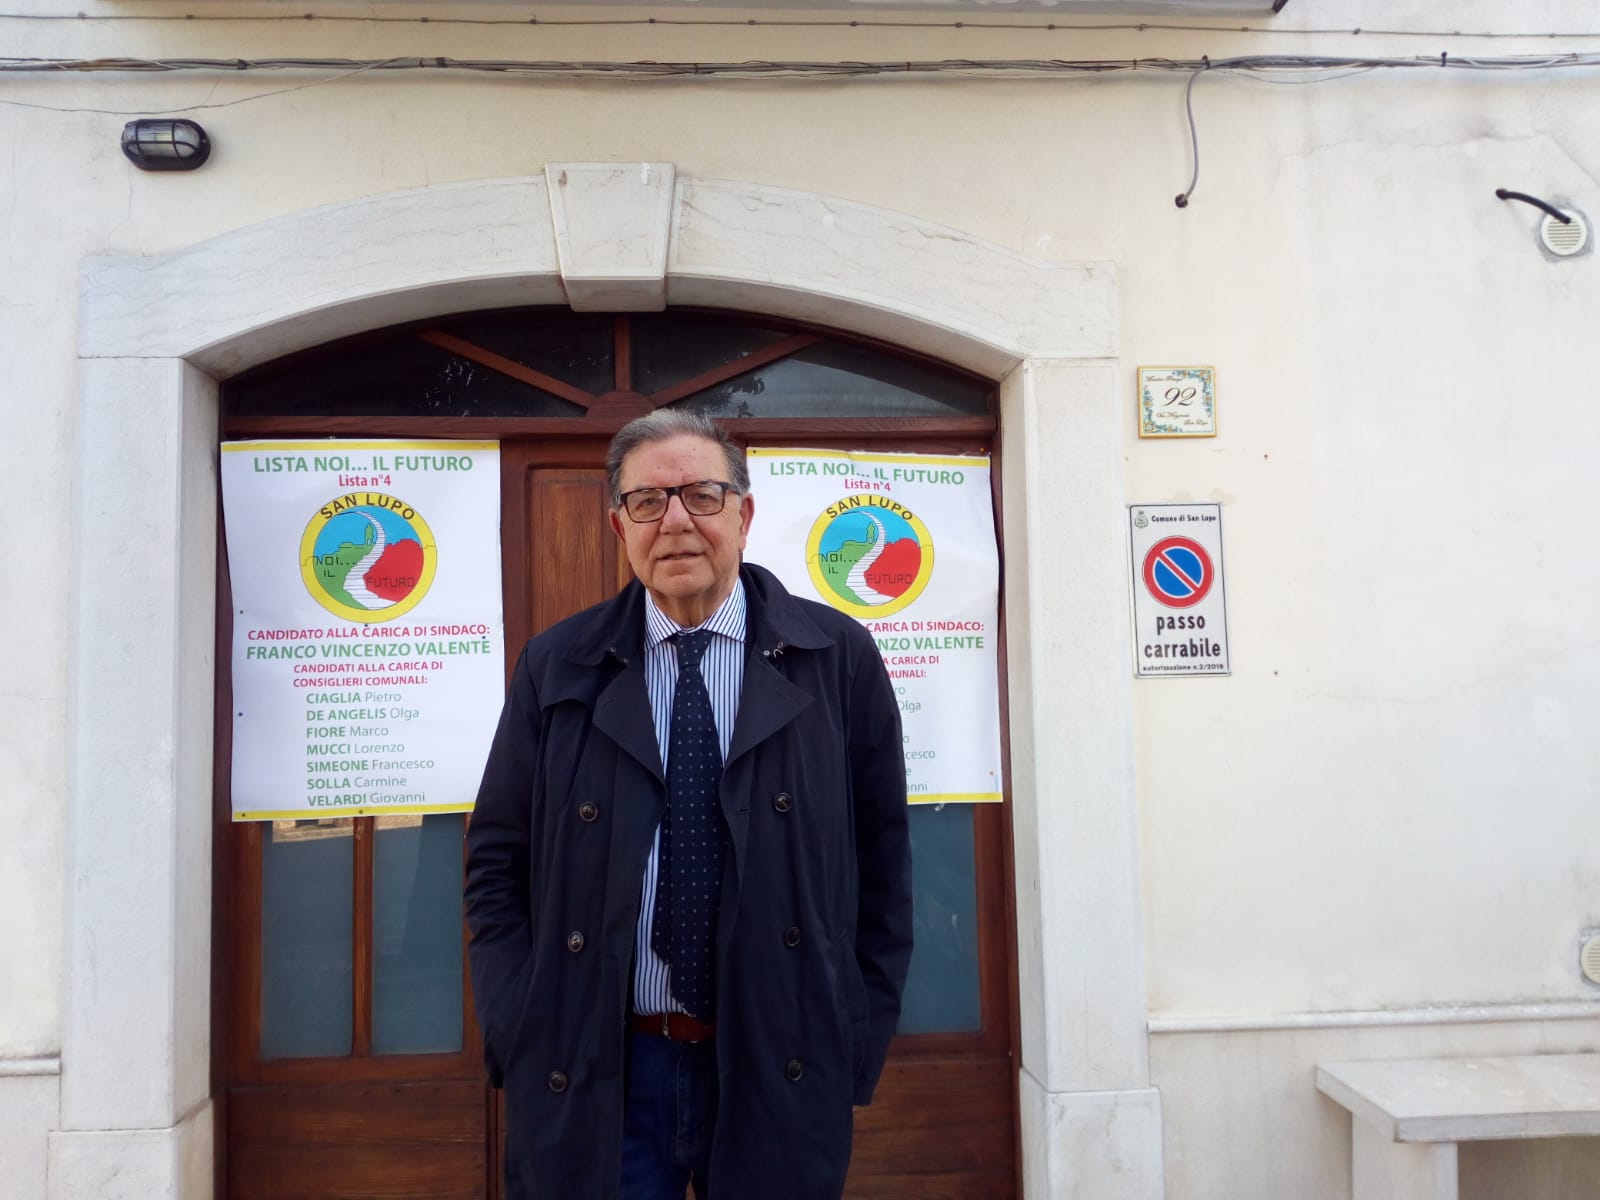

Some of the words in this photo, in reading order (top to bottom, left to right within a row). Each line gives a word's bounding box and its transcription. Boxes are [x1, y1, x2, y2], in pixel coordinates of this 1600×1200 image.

[1161, 387, 1197, 406] 92
[253, 456, 308, 473] LISTA
[314, 456, 368, 472] NOI...
[373, 456, 389, 471] IL
[394, 456, 473, 471] FUTURO
[339, 474, 367, 487] Lista
[371, 474, 391, 486] n°4
[770, 462, 820, 476] LISTA
[823, 463, 870, 478] NOI...
[874, 468, 889, 480] IL
[893, 469, 964, 485] FUTURO
[844, 479, 871, 490] Lista
[873, 480, 891, 491] n°4
[320, 494, 358, 520] SAN
[366, 494, 415, 520] LUPO
[826, 495, 861, 519] SAN
[868, 495, 913, 520] LUPO
[1201, 514, 1217, 523] Lupo
[366, 577, 416, 588] FUTURO
[866, 574, 913, 585] FUTURO
[247, 628, 323, 641] CANDIDATO
[326, 627, 359, 639] ALLA
[362, 626, 410, 638] CARICA
[413, 625, 427, 637] DI
[430, 624, 491, 636] SINDACO:
[866, 621, 909, 632] CARICA
[911, 621, 924, 631] DI
[927, 621, 985, 632] SINDACO:
[1156, 615, 1206, 636] passo
[914, 636, 985, 650] VALENTE
[1144, 638, 1221, 659] carrabile
[246, 645, 317, 660] FRANCO
[320, 643, 411, 658] VINCENZO
[415, 641, 491, 656] VALENTE
[891, 656, 927, 665] CARICA
[929, 655, 940, 664] DI
[293, 664, 355, 674] CANDIDATI
[357, 663, 386, 673] ALLA
[388, 661, 429, 672] CARICA
[431, 661, 443, 671] DI
[888, 670, 927, 679] MUNALI:
[293, 677, 363, 688] CONSIGLIERI
[365, 676, 428, 687] COMUNALI:
[306, 692, 362, 704] CIAGLIA
[365, 691, 402, 703] Pietro
[306, 710, 325, 722] DE
[327, 708, 387, 721] ANGELIS
[390, 706, 420, 722] Olga
[306, 726, 346, 739] FIORE
[349, 725, 390, 738] Marco
[306, 743, 351, 756] MUCCI
[354, 742, 405, 754] Lorenzo
[905, 750, 936, 760] cesco
[306, 760, 369, 773] SIMEONE
[372, 758, 435, 771] Francesco
[307, 777, 351, 790] SOLLA
[354, 775, 407, 789] Carmine
[307, 794, 367, 807] VELARDI
[370, 791, 426, 804] Giovanni
